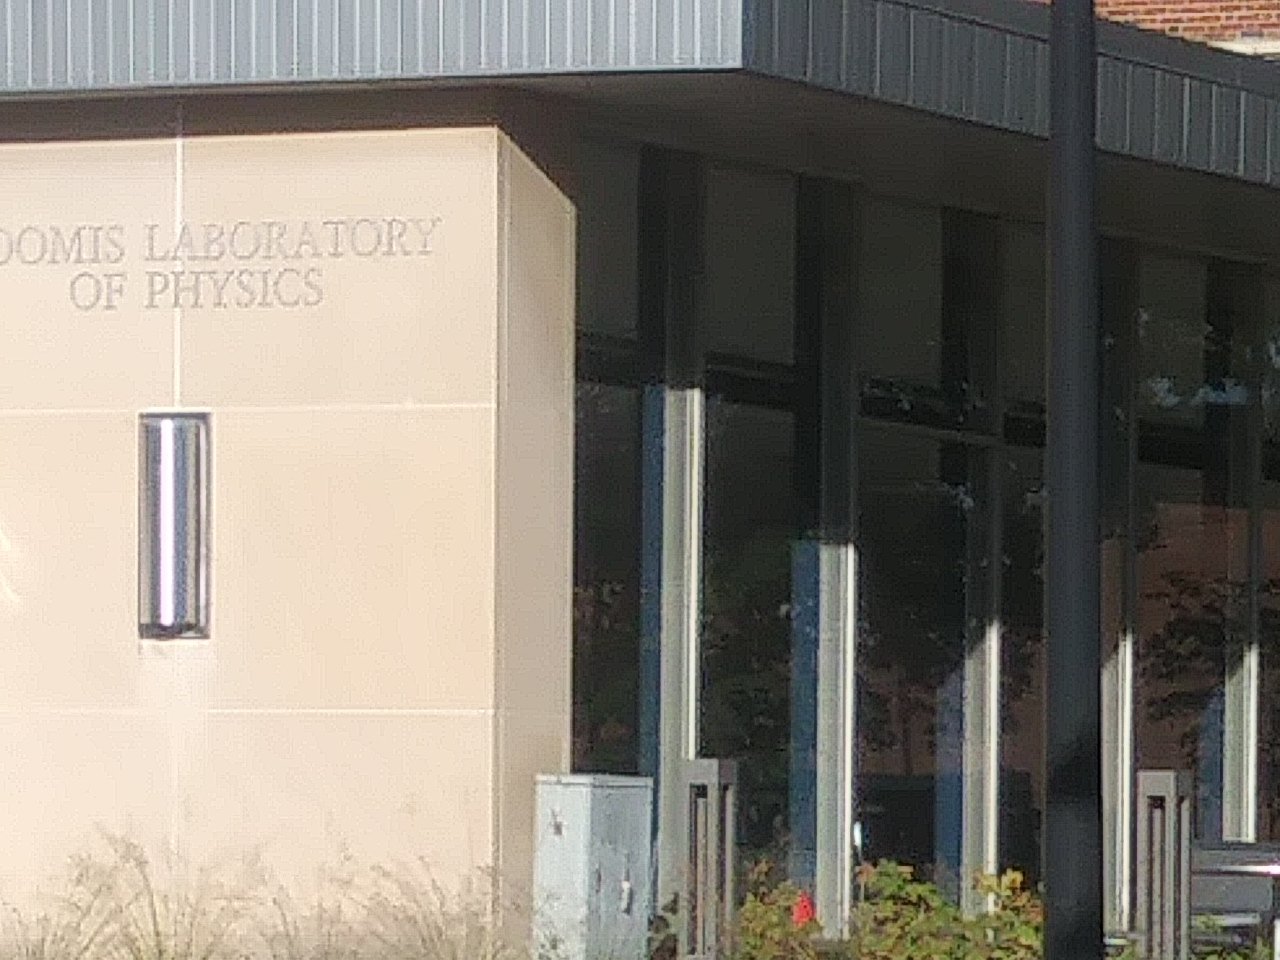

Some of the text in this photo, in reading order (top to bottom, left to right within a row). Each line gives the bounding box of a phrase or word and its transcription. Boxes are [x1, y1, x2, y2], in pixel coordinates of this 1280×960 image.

[144, 216, 442, 262] LABORATORY
[70, 268, 325, 311] OF PHYSICS
